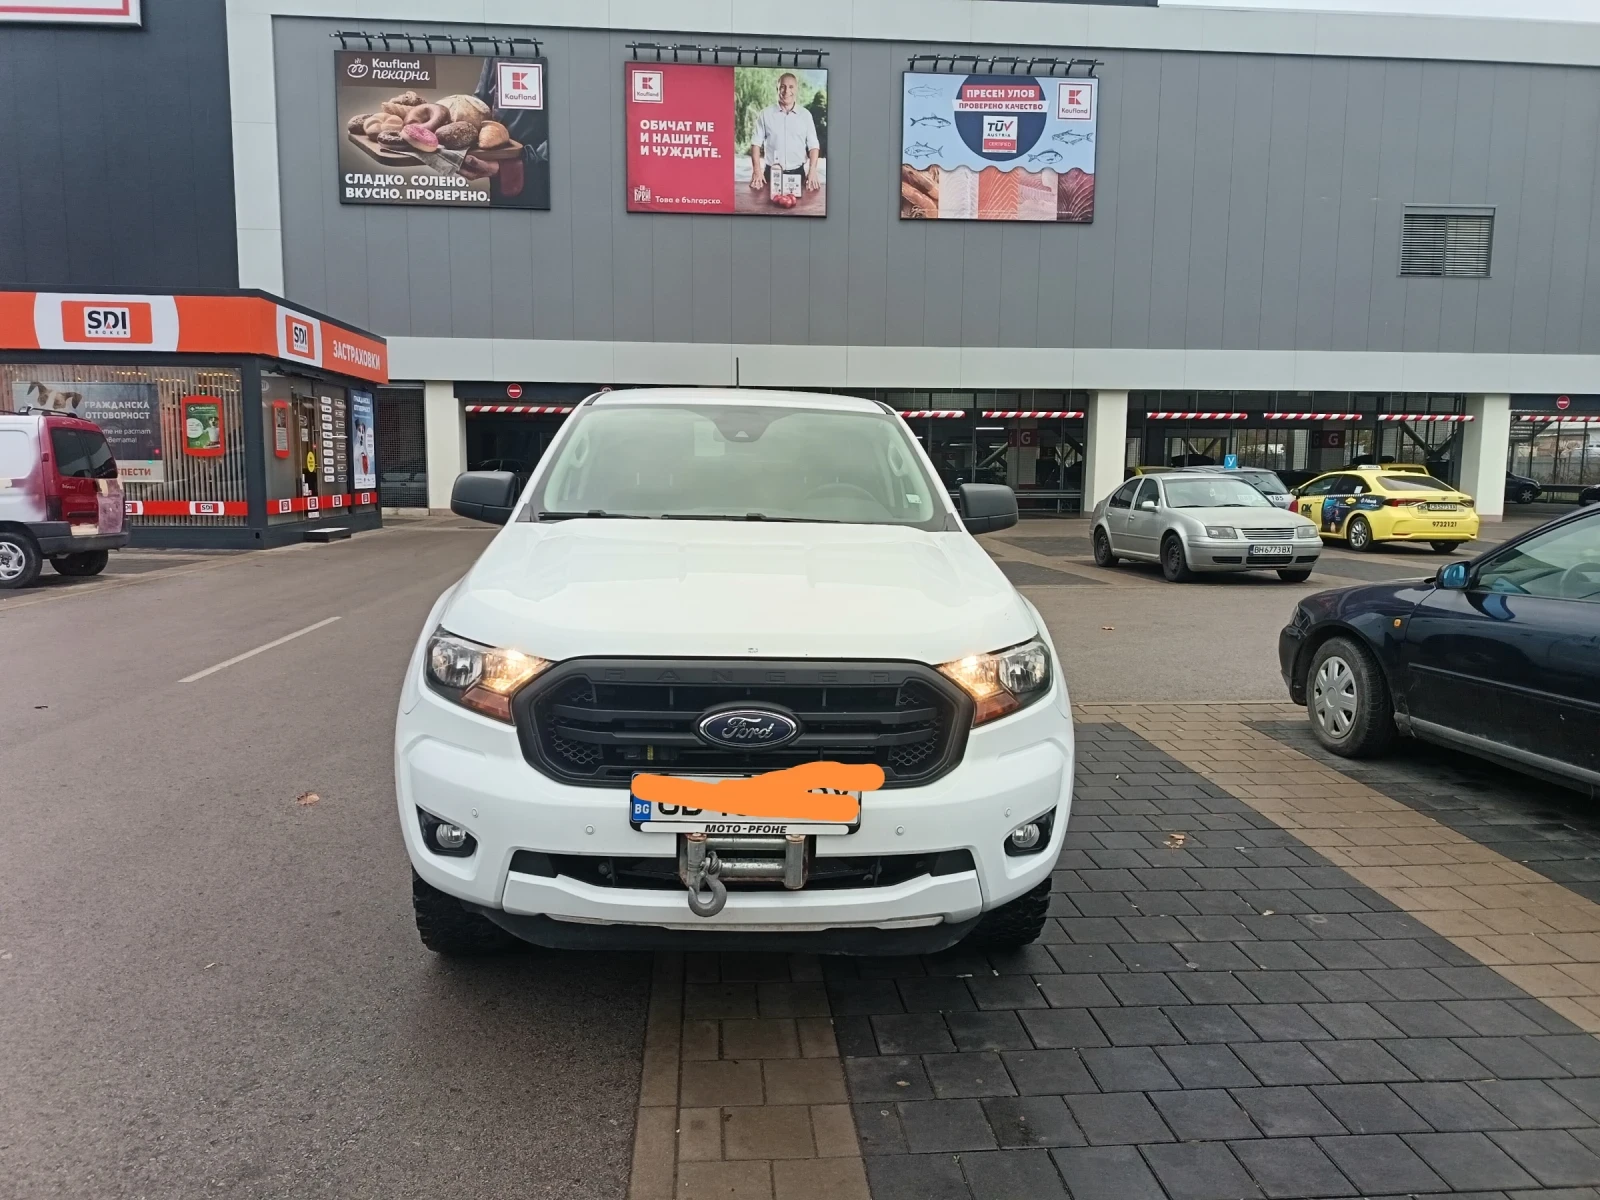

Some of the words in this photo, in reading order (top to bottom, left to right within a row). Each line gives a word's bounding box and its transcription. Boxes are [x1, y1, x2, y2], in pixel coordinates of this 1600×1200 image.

[372, 58, 420, 69] Kaufland
[372, 69, 430, 83] пекарна
[504, 93, 537, 101] Kaufland
[966, 89, 1004, 98] ПРЕСЕН
[1008, 89, 1035, 98] УЛОВ
[958, 102, 1003, 110] ПРОВЕРЕНО
[1004, 103, 1044, 111] КАЧЕСТВО
[640, 119, 692, 132] ОБИЧАТ
[696, 122, 714, 132] МЕ
[640, 132, 649, 143] И
[652, 133, 712, 147] НАШИТЕ,
[640, 146, 649, 155] И
[653, 146, 722, 159] ЧУЖДИТЕ.
[345, 173, 407, 186] СЛАДКО.
[411, 175, 469, 187] СОЛЕНО.
[345, 187, 403, 199] ВКУСНО.
[406, 189, 491, 202] ПРОВЕРЕНО.
[655, 195, 673, 203] Това
[681, 196, 722, 205] българско.
[87, 310, 127, 330] SDI
[293, 326, 307, 346] SDI
[332, 340, 381, 370] ЗАСТРАХОВКИ
[84, 401, 150, 409] ГРАЖДАНСКА
[85, 411, 150, 419] ОТГОВОРНОСТ
[604, 668, 890, 683] RANGER
[722, 716, 777, 740] Ford
[634, 803, 650, 814] BG
[704, 824, 788, 834] MOTO-PFOHE
